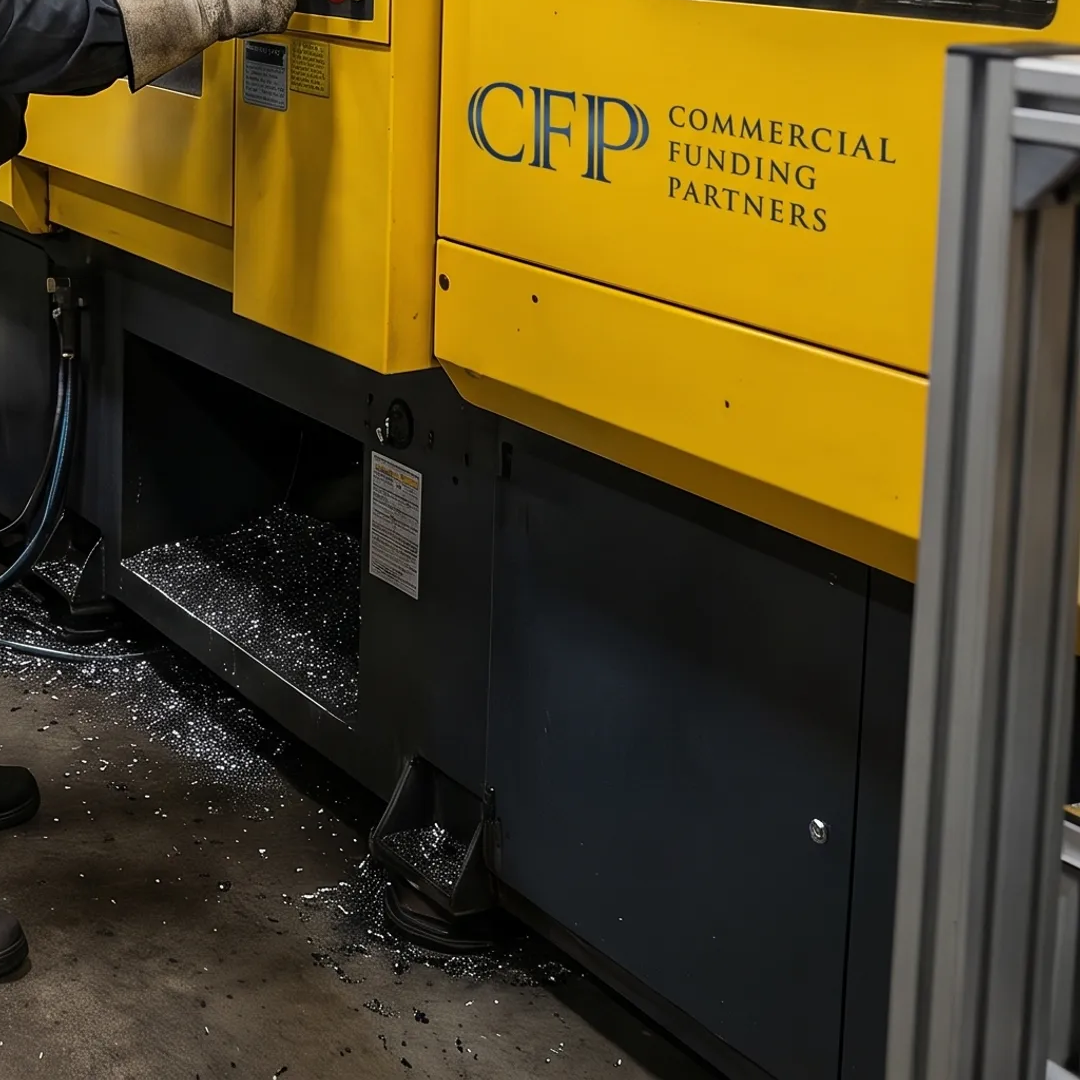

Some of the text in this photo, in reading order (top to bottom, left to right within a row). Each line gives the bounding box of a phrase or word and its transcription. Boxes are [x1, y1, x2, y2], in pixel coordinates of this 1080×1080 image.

[467, 81, 650, 184] CFP
[668, 105, 897, 165] COMMERCIAL
[668, 140, 816, 191] FUNDING
[668, 176, 827, 233] PARTNERS
